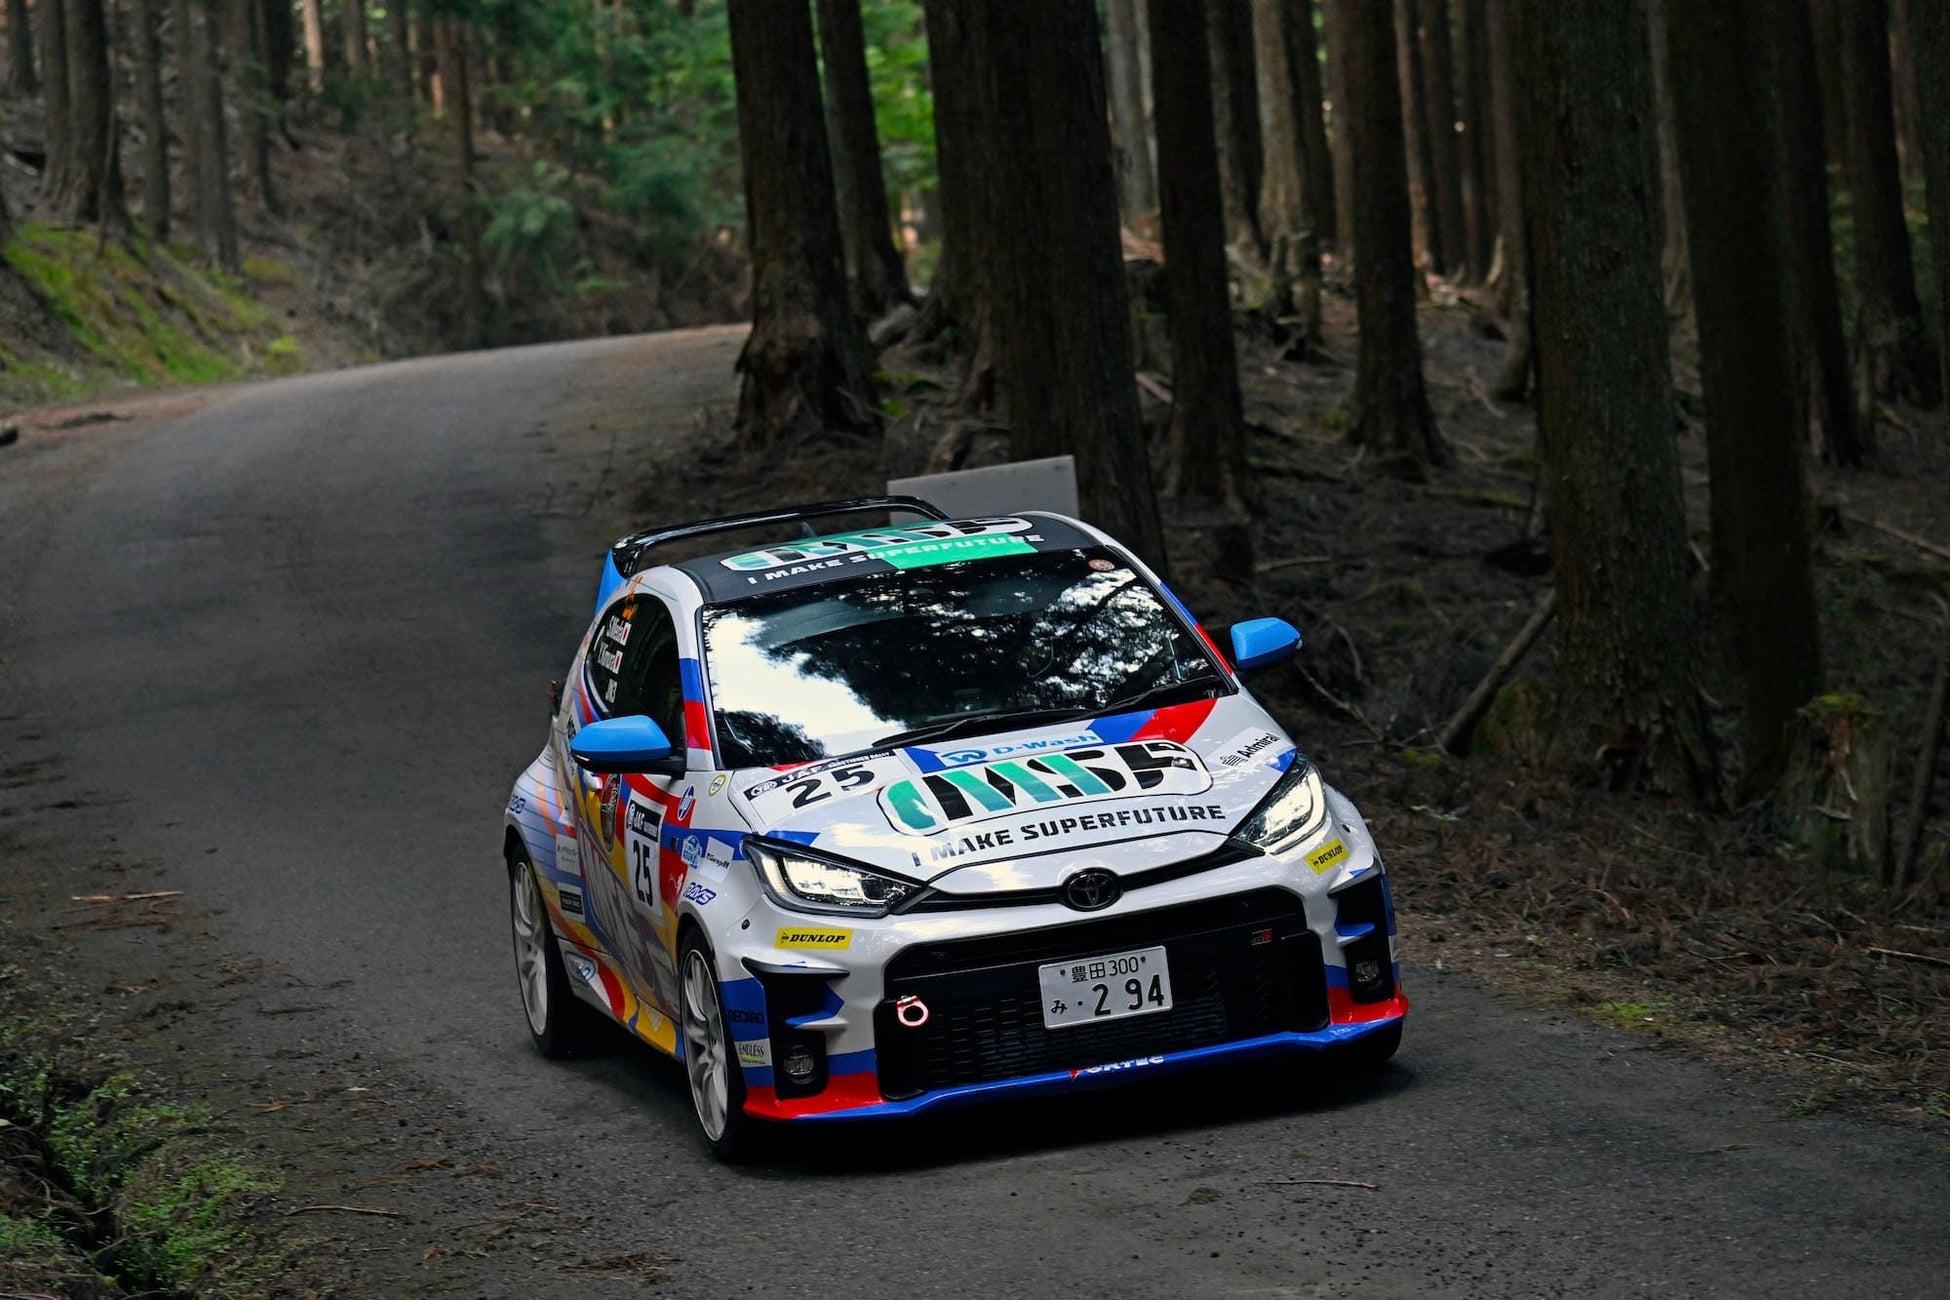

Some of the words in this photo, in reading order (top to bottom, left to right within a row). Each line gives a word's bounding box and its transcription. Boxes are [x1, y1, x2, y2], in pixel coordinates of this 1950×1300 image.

[746, 576, 757, 585] I
[764, 559, 844, 581] MAKE
[849, 534, 1045, 564] SUPERFUTURE
[992, 734, 1098, 755] D-Wash
[1236, 732, 1281, 758] Admiral
[785, 764, 875, 809] 25
[911, 851, 922, 867] I
[931, 829, 1015, 860] MAKE
[1020, 804, 1227, 842] SUPERFUTURE
[1318, 844, 1343, 865] DUNLOP
[633, 839, 654, 908] 25
[789, 934, 846, 943] DUNLOP
[739, 1043, 764, 1057] ENDLESS
